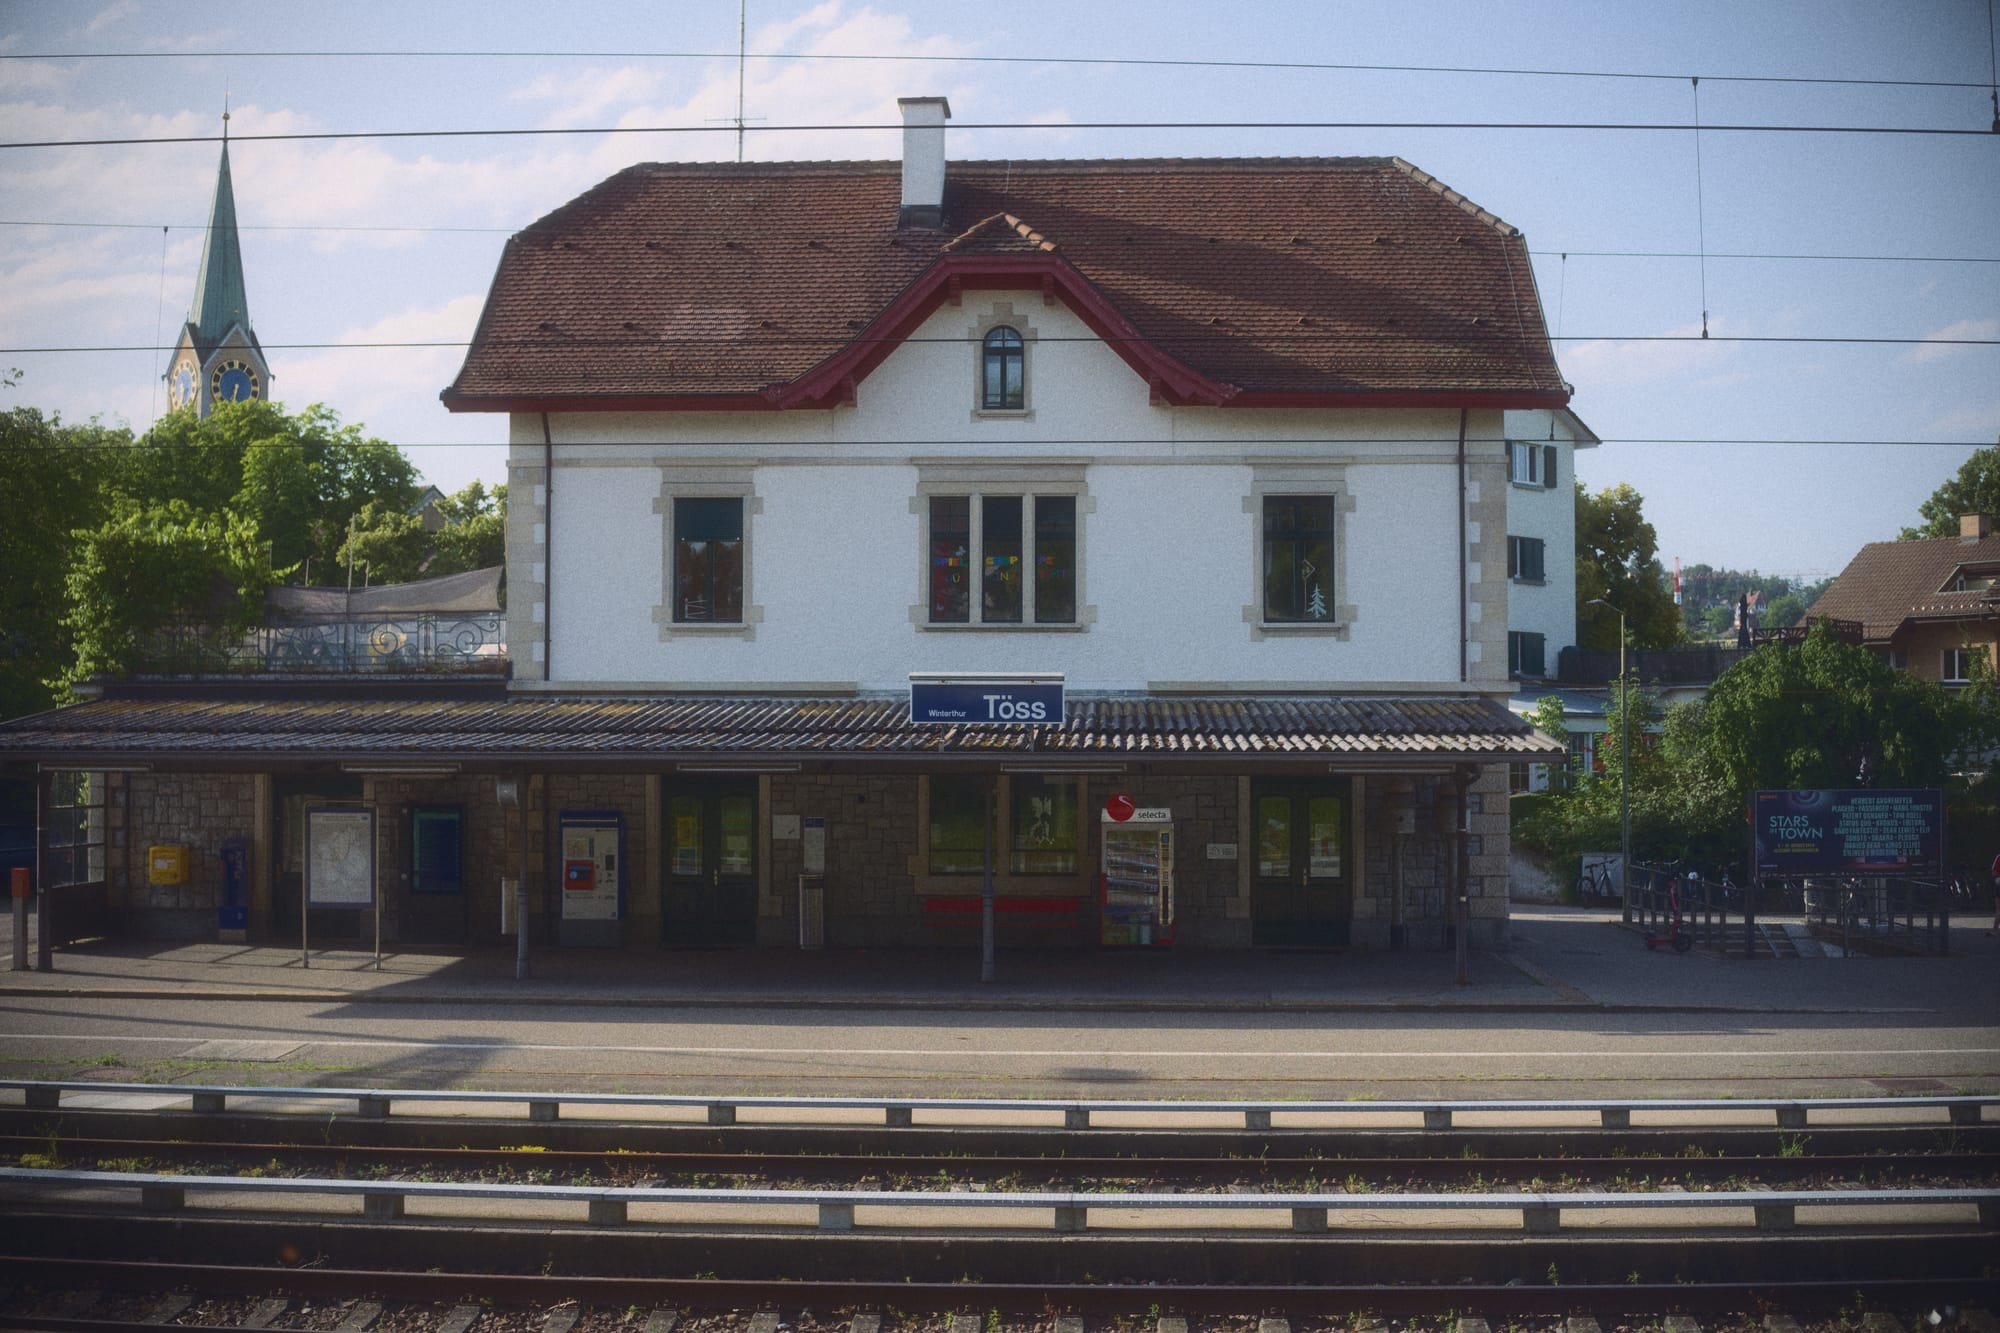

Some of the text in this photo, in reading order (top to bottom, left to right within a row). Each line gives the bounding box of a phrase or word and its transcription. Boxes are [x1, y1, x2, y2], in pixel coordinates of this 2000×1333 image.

[928, 695, 1047, 720] Winterthur Töss
[1138, 811, 1166, 819] selecta
[1769, 815, 1809, 828] STARS
[1779, 827, 1823, 839] TOWN
